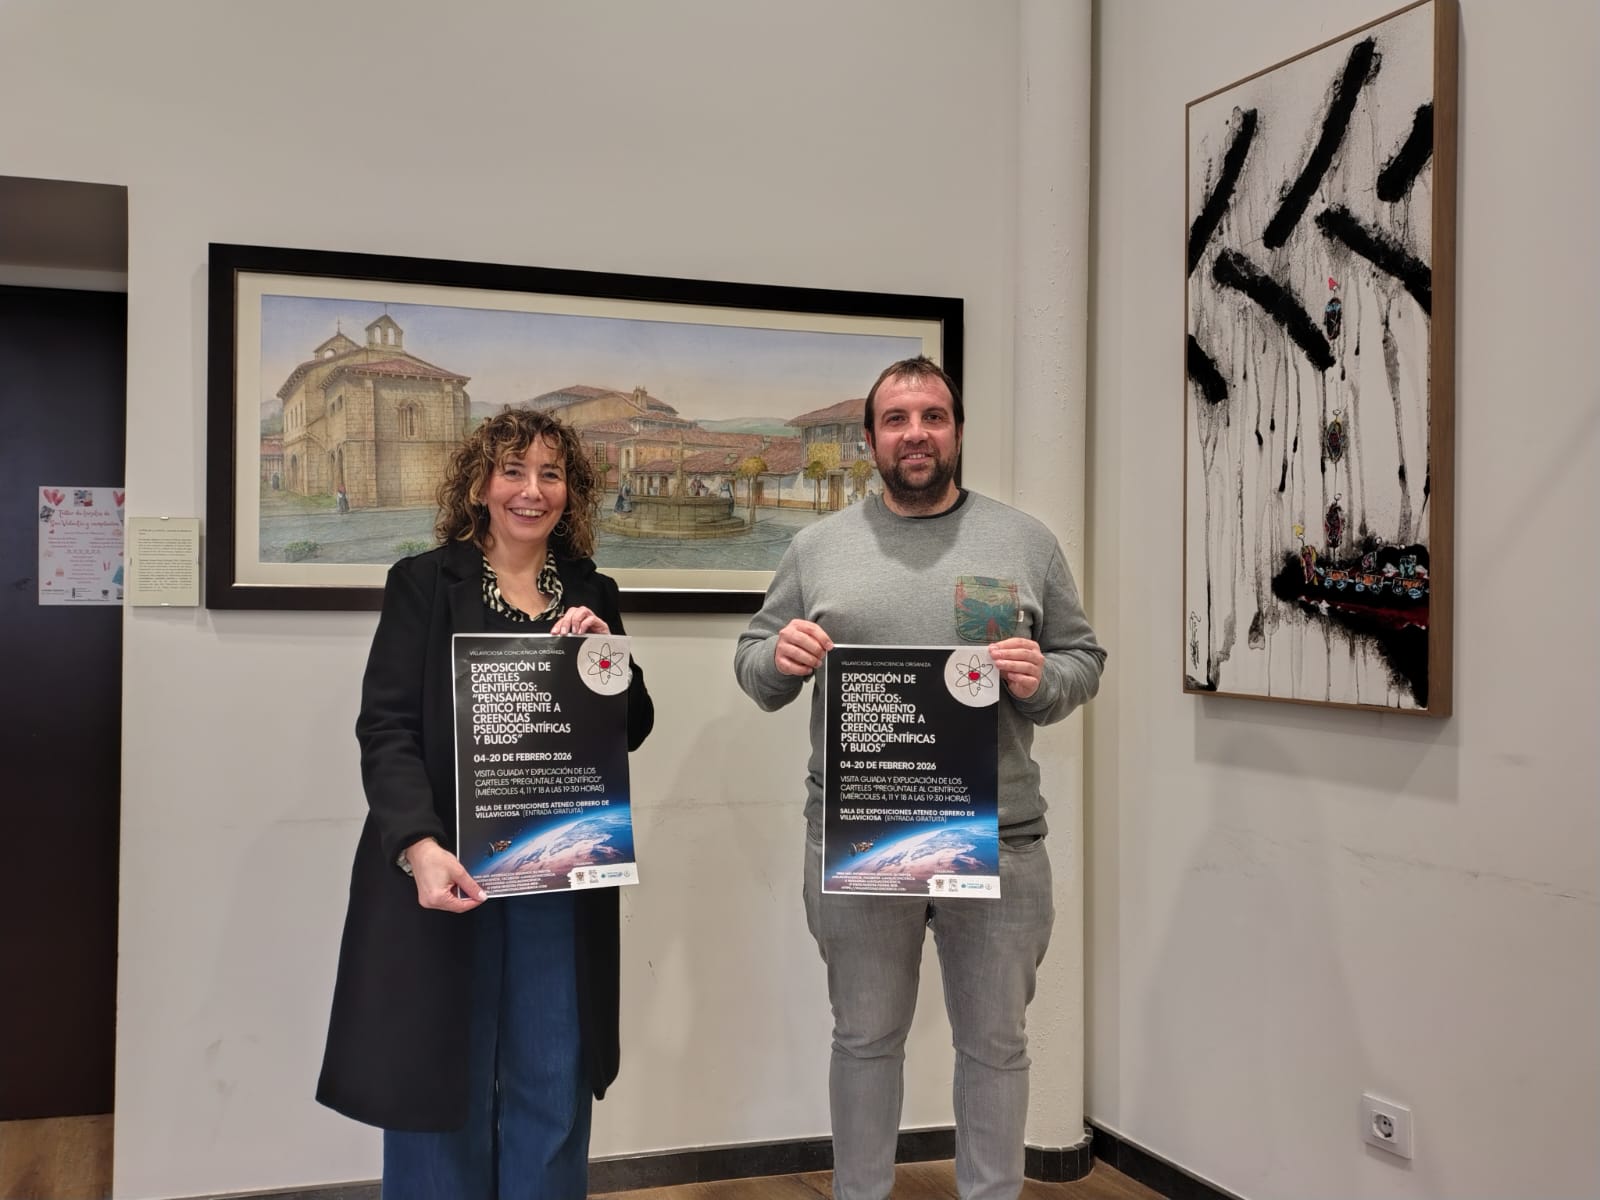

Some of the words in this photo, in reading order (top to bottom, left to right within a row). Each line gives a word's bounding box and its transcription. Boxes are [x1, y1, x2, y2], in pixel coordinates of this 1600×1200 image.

[471, 660, 535, 673] EXPOSICIÓN
[538, 662, 551, 671] DE
[471, 672, 520, 682] CARTELES
[842, 672, 901, 683] EXPOSICIÓN
[904, 674, 917, 684] DE
[842, 683, 886, 693] CARTELES
[516, 702, 551, 712] FRENTE
[554, 703, 561, 712] A
[473, 713, 530, 723] CREENCIAS
[881, 714, 915, 723] FRENTE
[918, 714, 926, 724] A
[473, 721, 571, 734] PSEUDOCIENTÍFICAS
[841, 723, 894, 732] CREENCIAS
[474, 736, 481, 745] Y
[841, 731, 936, 744] PSEUDOCIENTÍFICAS
[841, 743, 848, 752] Y
[474, 754, 500, 763] 04-20
[503, 754, 514, 762] DE
[516, 753, 552, 761] FEBRERO
[553, 752, 572, 761] 2026
[840, 761, 864, 769] 04-20
[866, 761, 877, 769] DE
[879, 761, 915, 770] FEBRERO
[917, 762, 936, 770] 2026
[531, 767, 573, 776] EXPLICACIÓN
[475, 778, 509, 787] CARTELES
[893, 776, 938, 784] EXPLICACIÓN
[580, 783, 604, 793] HORAS)
[944, 794, 970, 804] HORAS)
[504, 803, 549, 811] EXPOSICIONES
